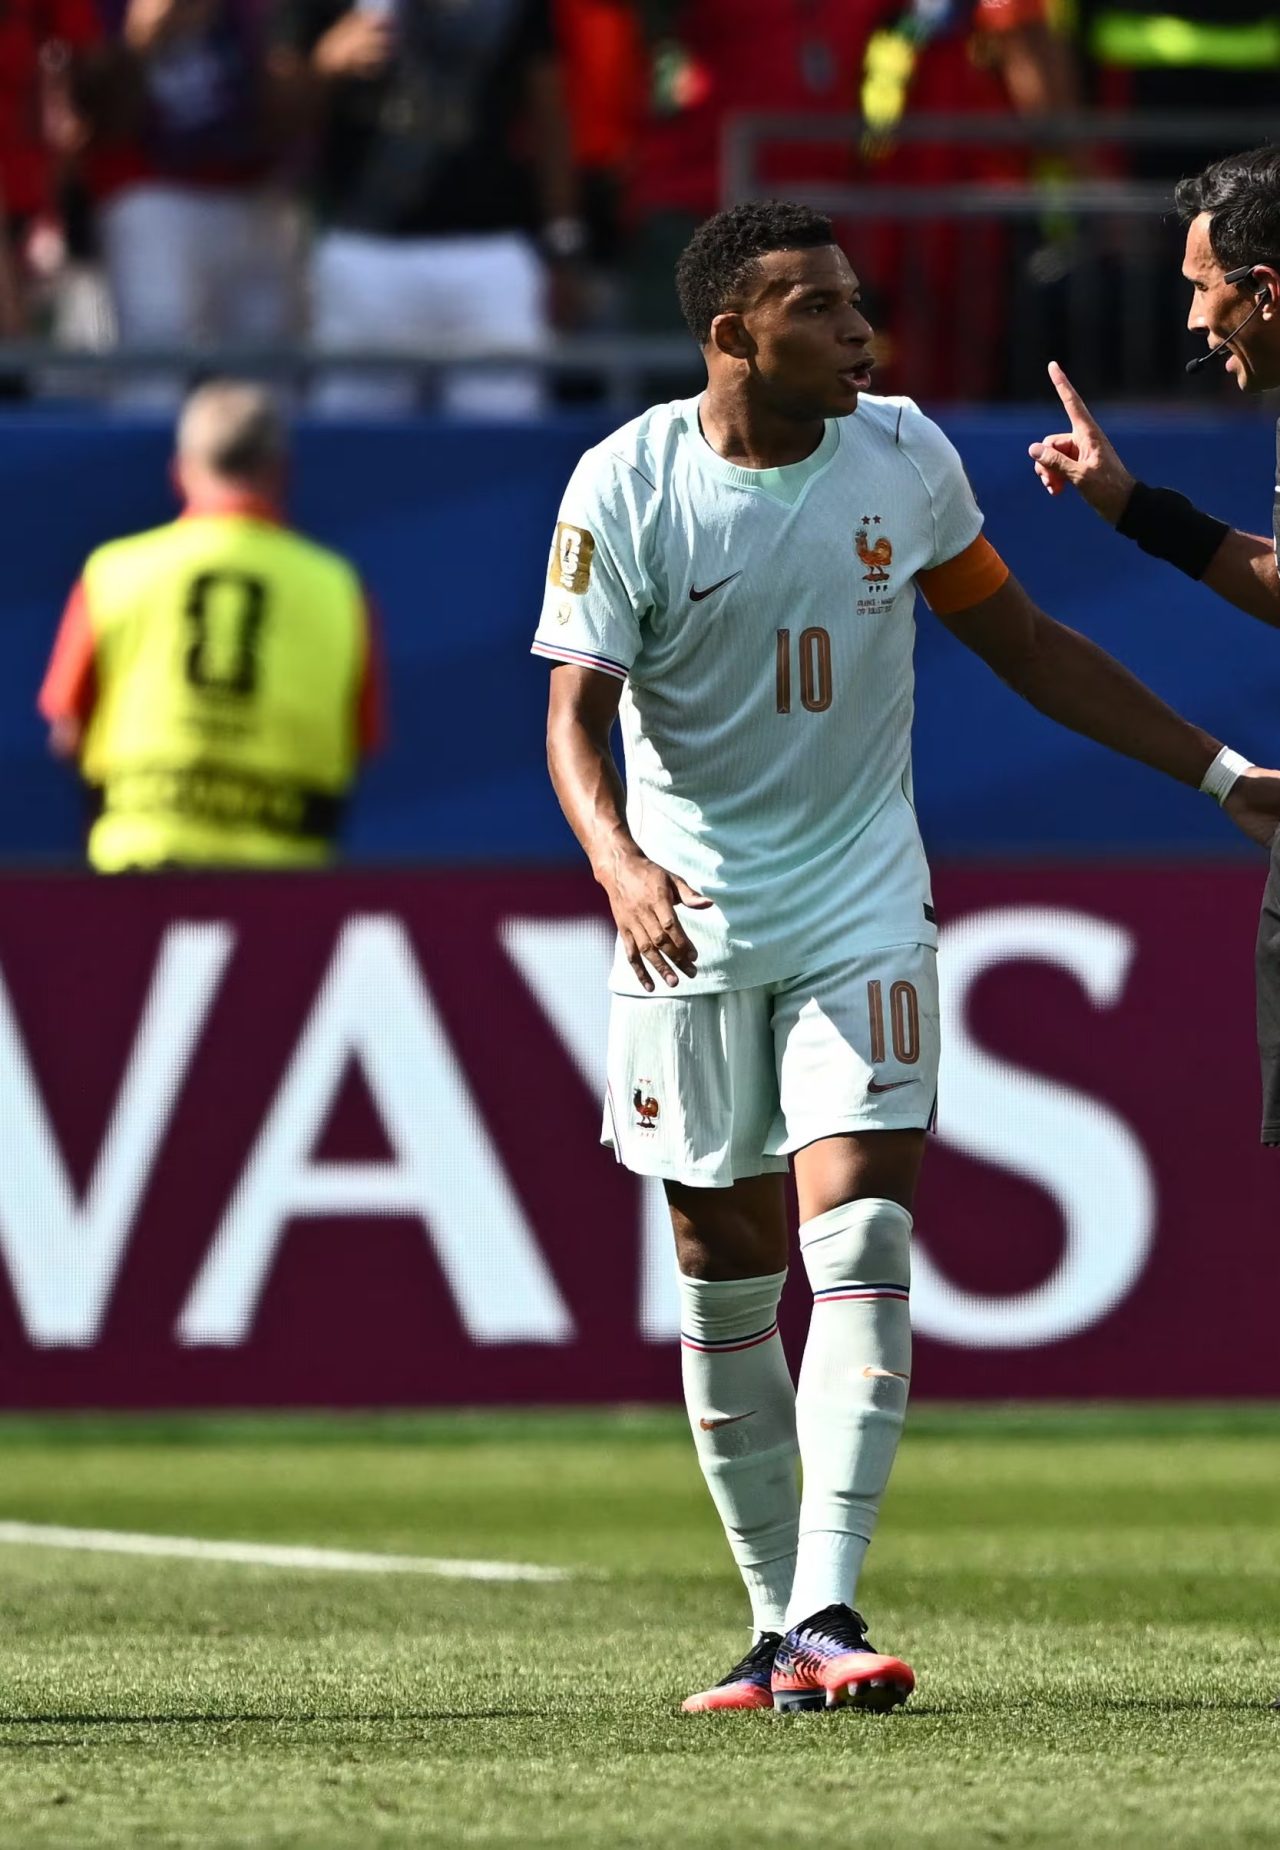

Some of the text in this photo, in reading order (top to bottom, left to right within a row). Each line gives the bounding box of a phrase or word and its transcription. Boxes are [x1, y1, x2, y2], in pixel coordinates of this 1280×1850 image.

[776, 626, 833, 714] 10
[867, 979, 920, 1065] 10
[0, 907, 1157, 1348] AS
